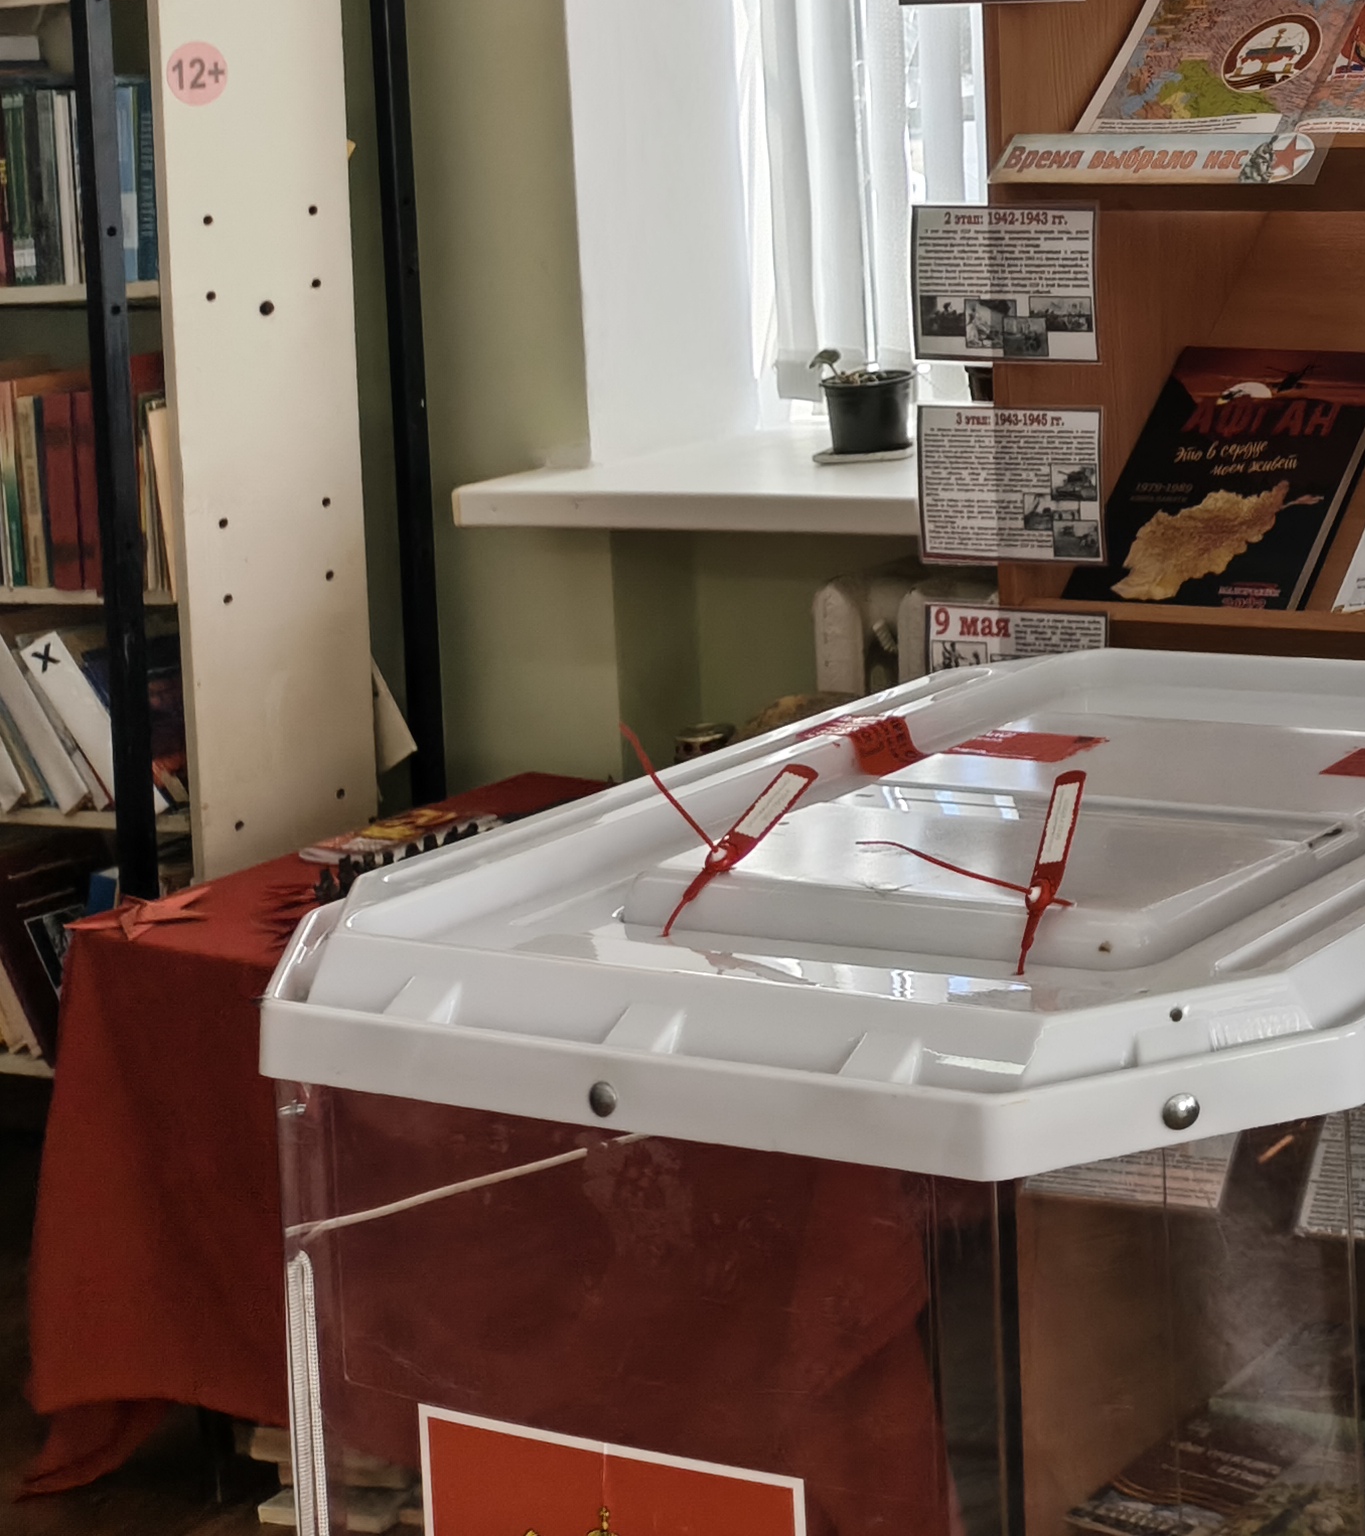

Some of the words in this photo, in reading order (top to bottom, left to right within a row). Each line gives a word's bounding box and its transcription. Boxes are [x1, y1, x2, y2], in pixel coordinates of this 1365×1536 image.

[170, 58, 226, 91] 12+
[1002, 145, 1085, 173] Время
[1087, 146, 1198, 174] выбрало
[1202, 148, 1251, 171] нас
[944, 211, 952, 225] 2
[954, 214, 984, 226] этап:
[987, 211, 1049, 226] 1942-1943
[956, 412, 963, 425] 3
[965, 414, 992, 426] этап:
[994, 412, 1048, 427] 1943-1945
[1180, 399, 1344, 438] АФГАН
[1174, 446, 1203, 464] Это
[1206, 440, 1219, 461] в
[1220, 440, 1269, 462] сердце
[934, 607, 950, 635] 9
[959, 616, 1011, 638] мая
